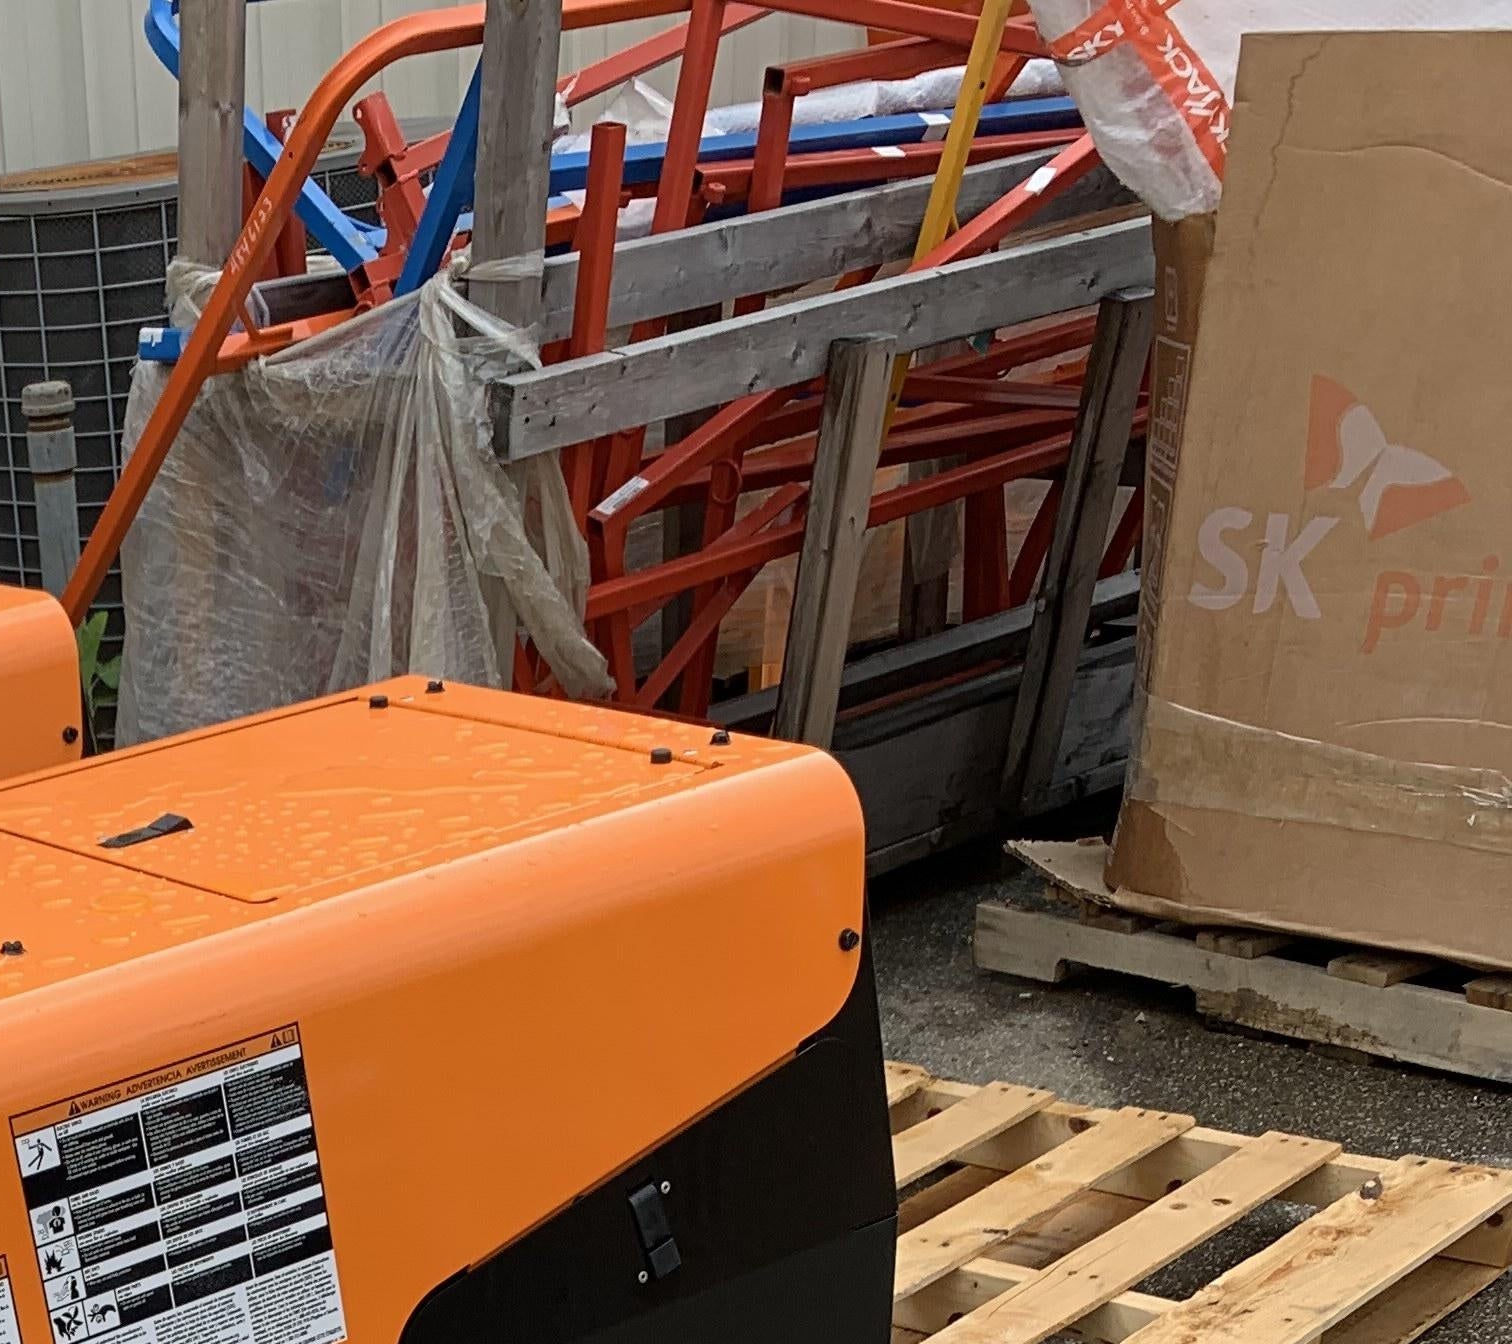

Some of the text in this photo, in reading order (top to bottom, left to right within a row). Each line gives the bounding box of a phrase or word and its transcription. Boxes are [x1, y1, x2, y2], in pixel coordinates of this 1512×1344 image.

[1188, 506, 1340, 619] SK
[1361, 554, 1512, 655] pri
[79, 1046, 247, 1111] WARNING ADVERTENCIA AVERTISSEMENT
